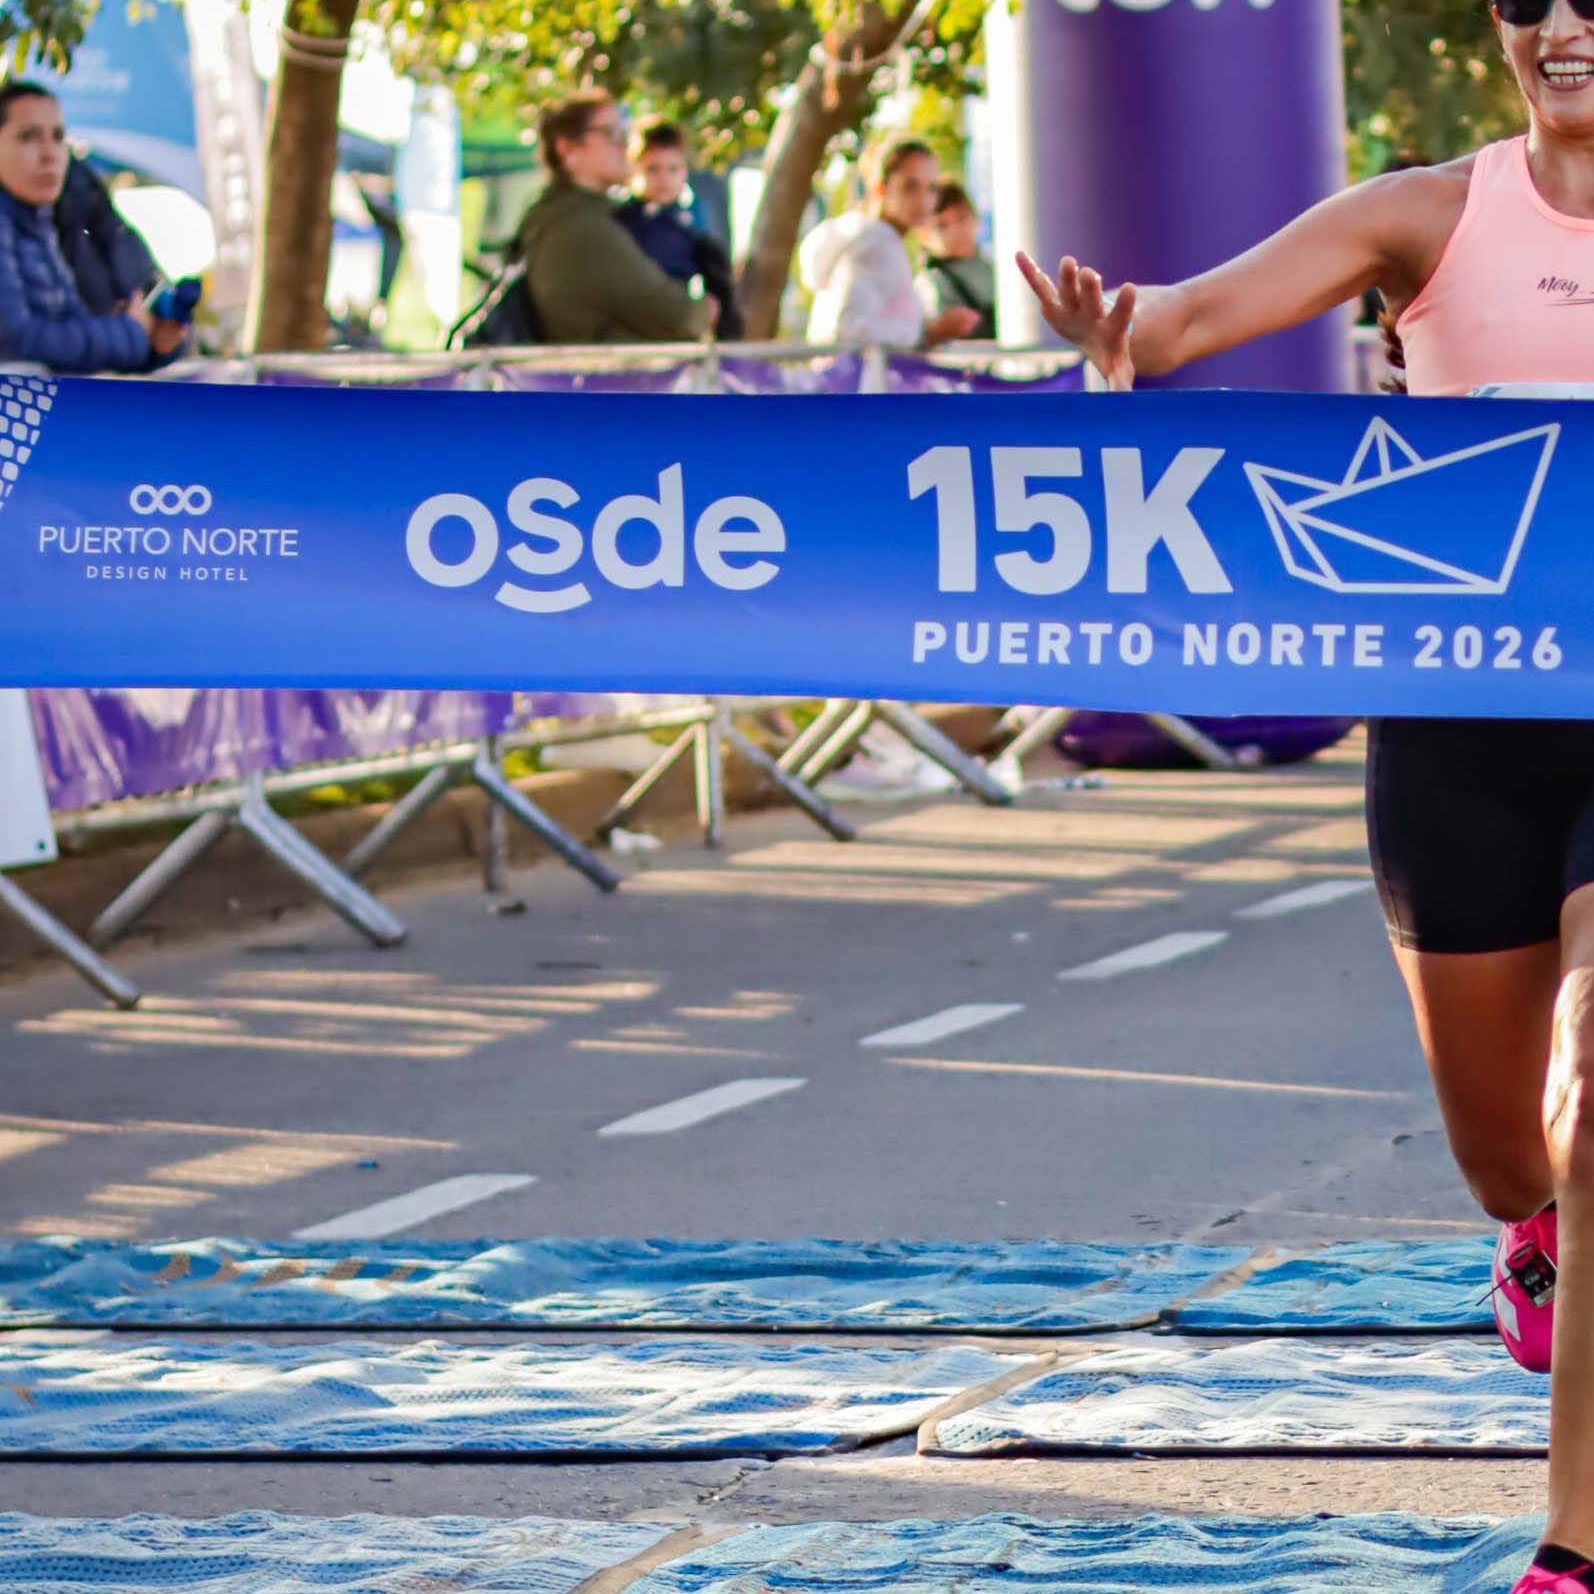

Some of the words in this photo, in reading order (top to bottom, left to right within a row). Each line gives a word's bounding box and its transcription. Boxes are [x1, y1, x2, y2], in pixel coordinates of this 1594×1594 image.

[39, 525, 172, 556] PUERTO
[182, 527, 299, 557] NORTE
[405, 462, 786, 592] osde
[907, 445, 1234, 596] 15K
[86, 565, 168, 580] DESIGN
[179, 566, 249, 581] HOTEL
[912, 620, 1154, 666] PUERTO
[1182, 622, 1384, 668] NORTE
[1412, 624, 1563, 671] 2026
